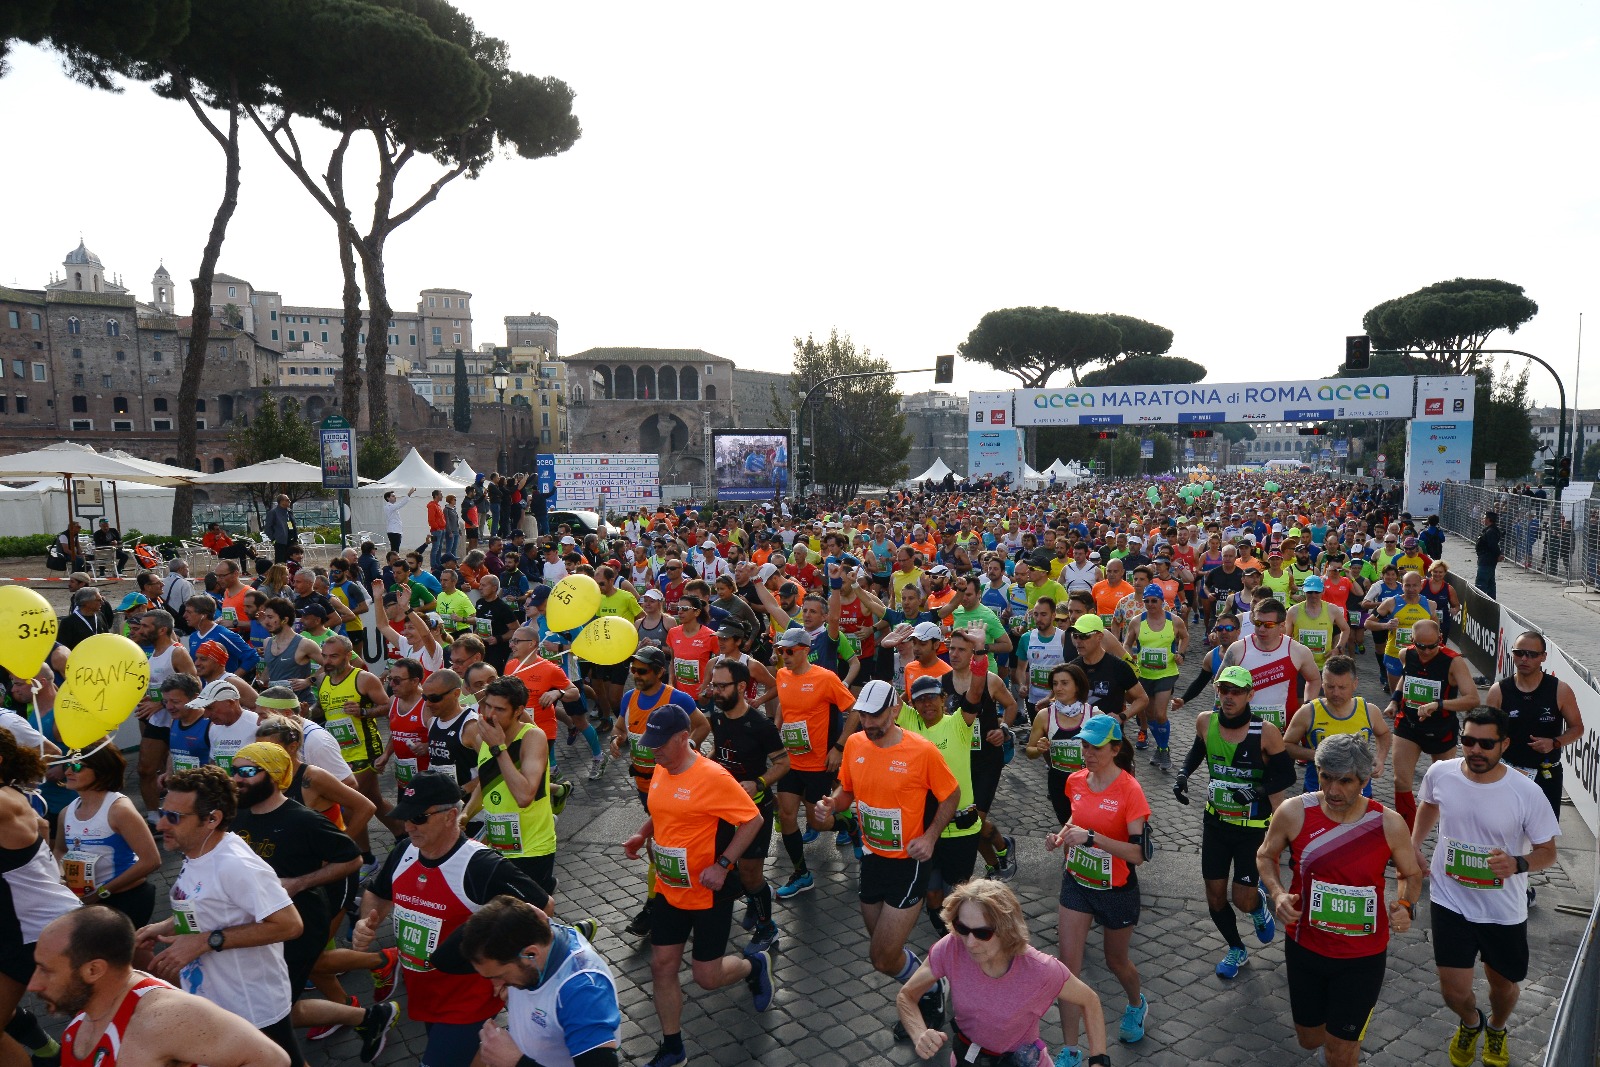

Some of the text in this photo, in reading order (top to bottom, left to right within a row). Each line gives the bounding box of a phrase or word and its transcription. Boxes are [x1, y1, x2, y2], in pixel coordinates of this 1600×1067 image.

[1034, 383, 1390, 409] acea MARATONA di ROMA acea
[18, 619, 56, 640] 3:45
[1466, 612, 1496, 657] RADIO 105
[75, 660, 138, 687] FRANK
[428, 746, 450, 760] PACER
[869, 818, 886, 832] 1294
[1309, 827, 1326, 839] Joma
[1450, 840, 1477, 853] acea
[1315, 884, 1347, 895] acea
[395, 892, 447, 911] INTESA SANPAOLO
[1331, 898, 1356, 914] 9315
[395, 907, 417, 923] acea
[402, 925, 422, 945] 4763
